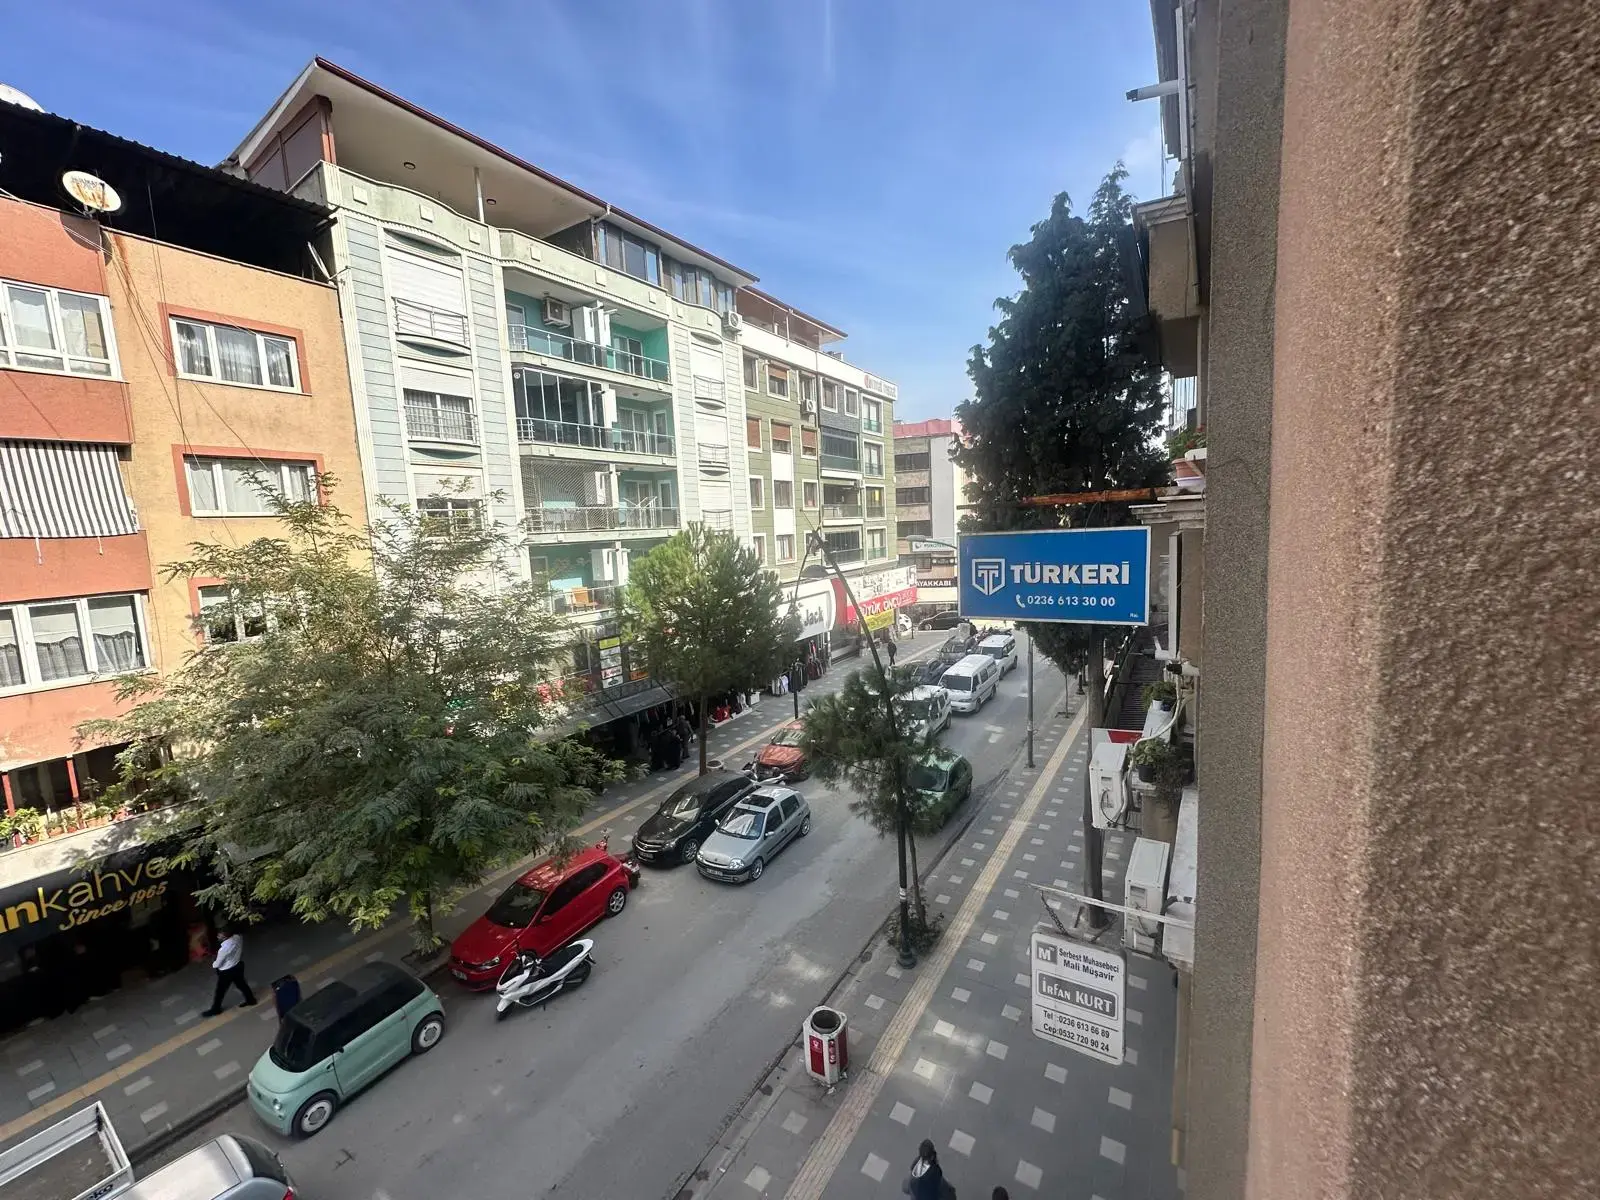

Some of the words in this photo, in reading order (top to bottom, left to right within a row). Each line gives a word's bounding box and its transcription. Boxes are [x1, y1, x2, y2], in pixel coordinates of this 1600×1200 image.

[1010, 561, 1129, 584] TÜRKERİ
[1027, 595, 1054, 605] 0236
[1058, 595, 1079, 606] 613
[1082, 596, 1097, 606] 30
[1100, 597, 1115, 607] 00
[59, 897, 129, 931] Since
[129, 881, 168, 907] 1965
[1058, 947, 1082, 962] Serbest
[1063, 959, 1080, 971] Mali
[1075, 990, 1112, 1013] KURT
[1076, 1021, 1089, 1032] 613
[1076, 1034, 1089, 1045] 720
[1090, 1038, 1099, 1048] 90
[1101, 1042, 1110, 1052] 24
